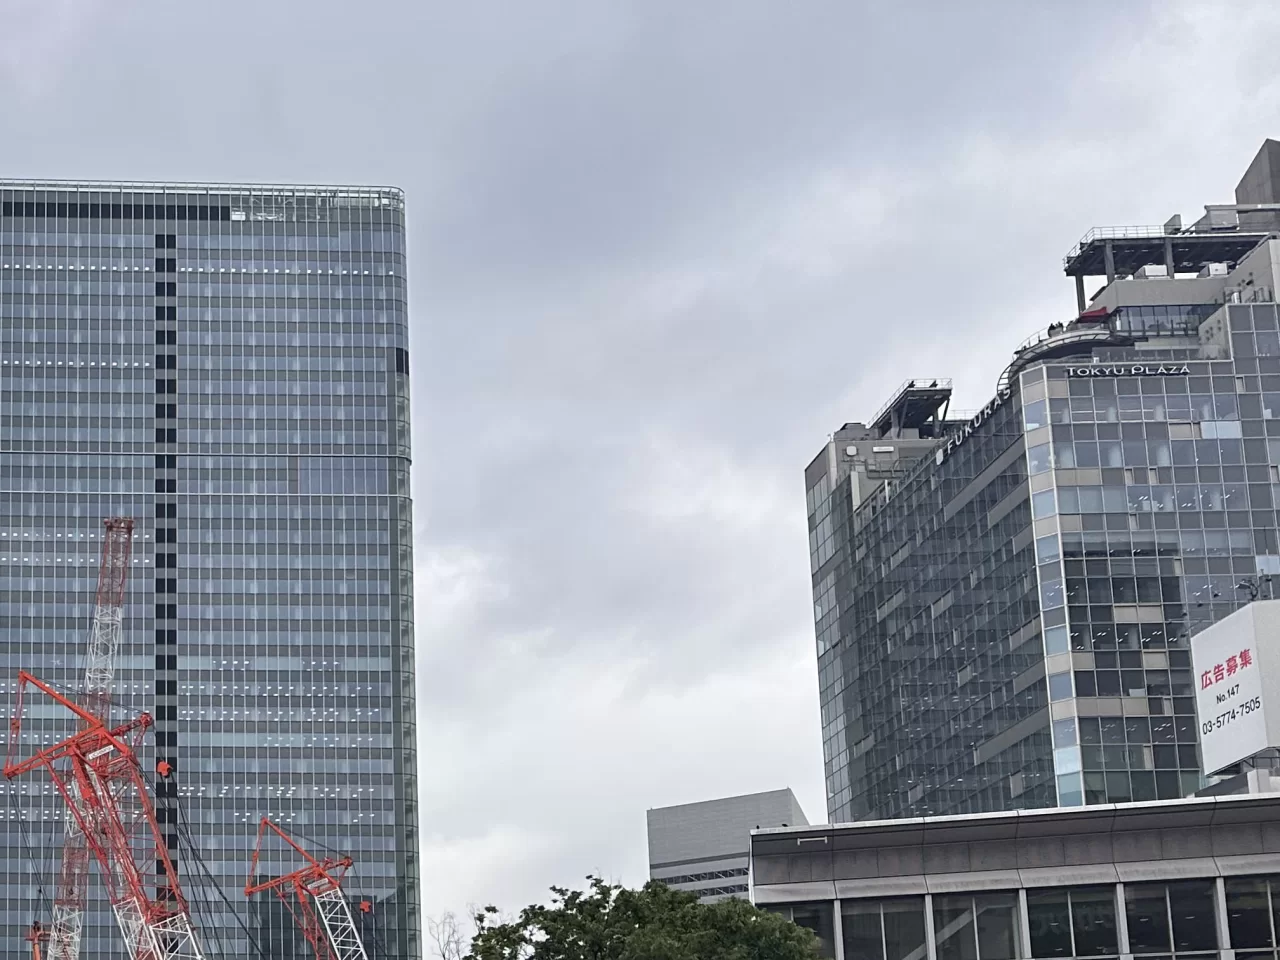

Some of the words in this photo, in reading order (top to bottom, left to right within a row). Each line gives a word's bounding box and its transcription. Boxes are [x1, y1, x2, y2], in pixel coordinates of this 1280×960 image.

[1066, 366, 1125, 377] TOKYU
[1131, 365, 1191, 375] PLAZA
[947, 386, 1011, 454] FUKURAS
[1200, 648, 1253, 690] 広告募集
[1216, 683, 1240, 705] No.147
[1202, 696, 1262, 735] 03-5774-7505
